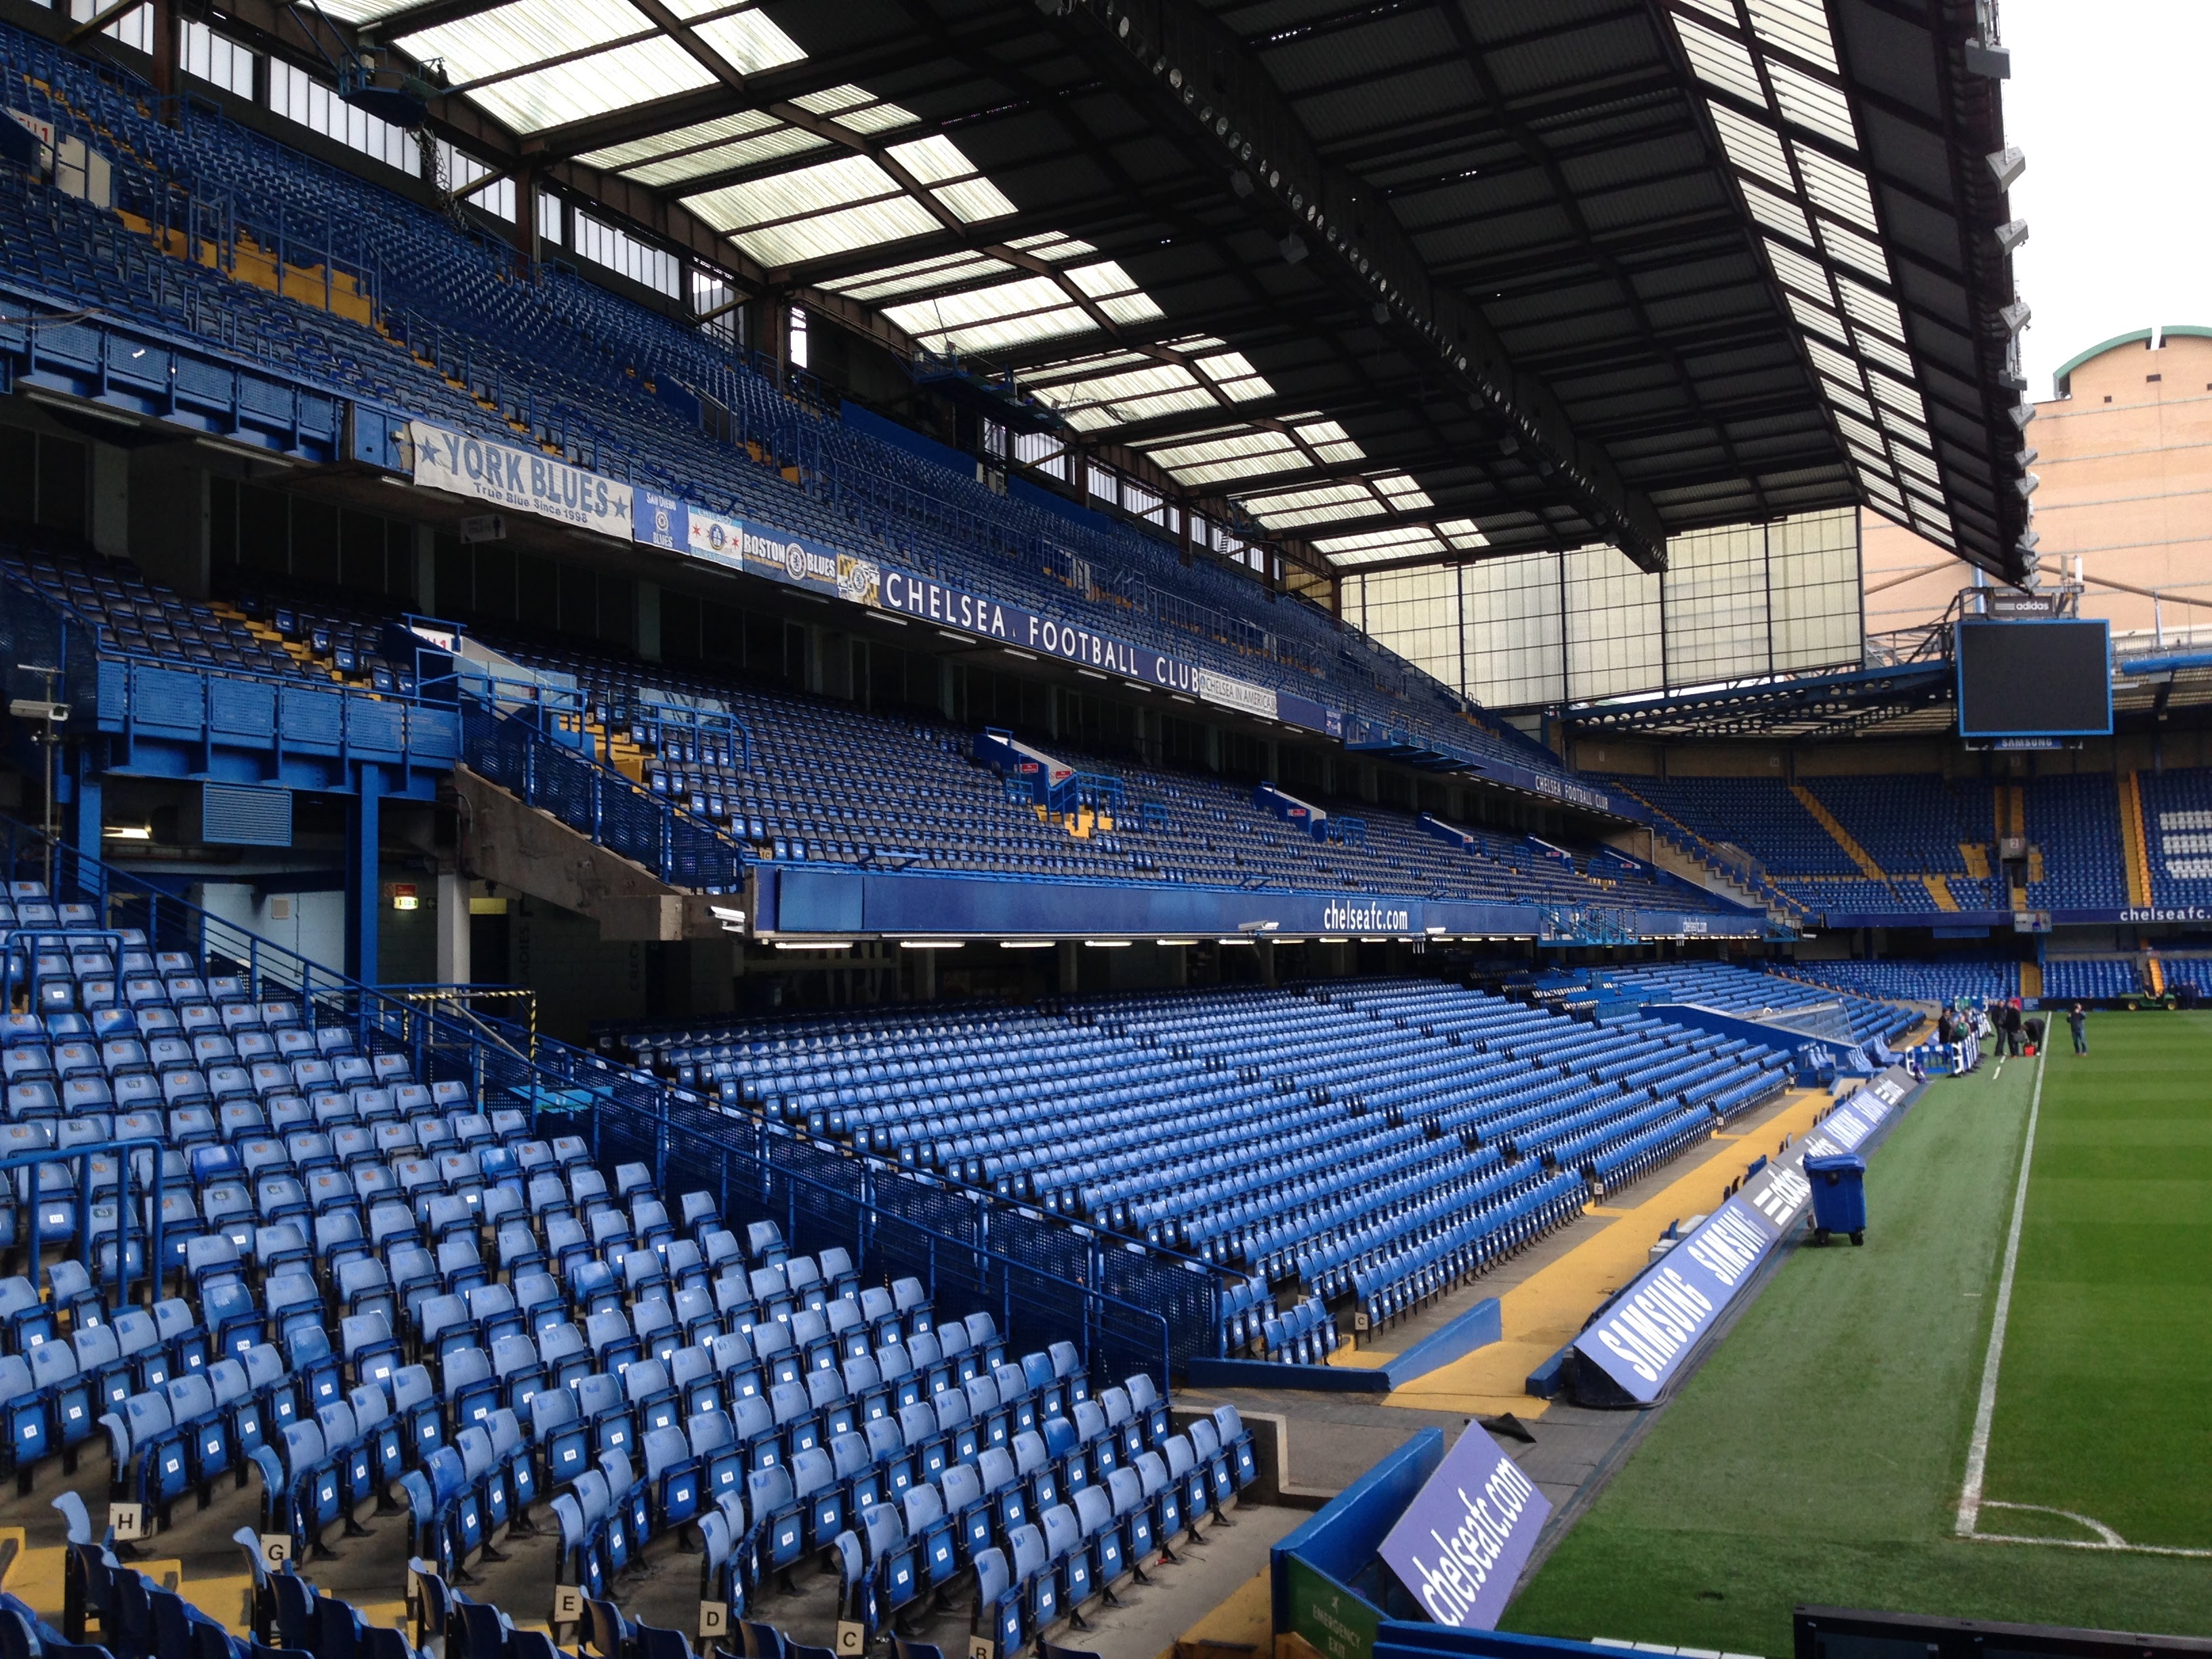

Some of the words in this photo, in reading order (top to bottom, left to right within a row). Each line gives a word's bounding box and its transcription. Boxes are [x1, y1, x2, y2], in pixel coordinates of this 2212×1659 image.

[442, 433, 525, 494] YORK
[530, 456, 609, 518] BLUES
[473, 481, 502, 500] True
[506, 493, 529, 508] Blue
[533, 498, 561, 517] Since
[563, 510, 588, 524] 1998
[743, 533, 785, 563] BOSTON
[806, 552, 836, 578] BLUES
[2015, 600, 2049, 611] adidas
[886, 573, 1006, 638] CHELSEA
[1029, 615, 1139, 676] FOOTBALL
[1156, 656, 1199, 693] CLUB
[1206, 677, 1233, 698] CHELSEA
[1235, 687, 1242, 700] IN
[1243, 690, 1271, 710] AMERICA
[2001, 738, 2052, 747] SAMSUNG
[1535, 775, 1561, 797] CHELSEA
[1565, 784, 1593, 806] FOOTBALL
[1324, 899, 1408, 930] chelseafc.com
[1687, 1205, 1770, 1287] SAMSUNG
[1357, 1317, 1365, 1326] C
[1597, 1267, 1713, 1382] SAMSUNG
[118, 1513, 134, 1530] H
[268, 1544, 284, 1561] G
[1412, 1457, 1533, 1627] chelseafc.com
[563, 1595, 575, 1612] E
[707, 1611, 720, 1626] D
[843, 1631, 857, 1647] C
[1312, 1604, 1361, 1650] EMERGENCY
[976, 1647, 987, 1659] B
